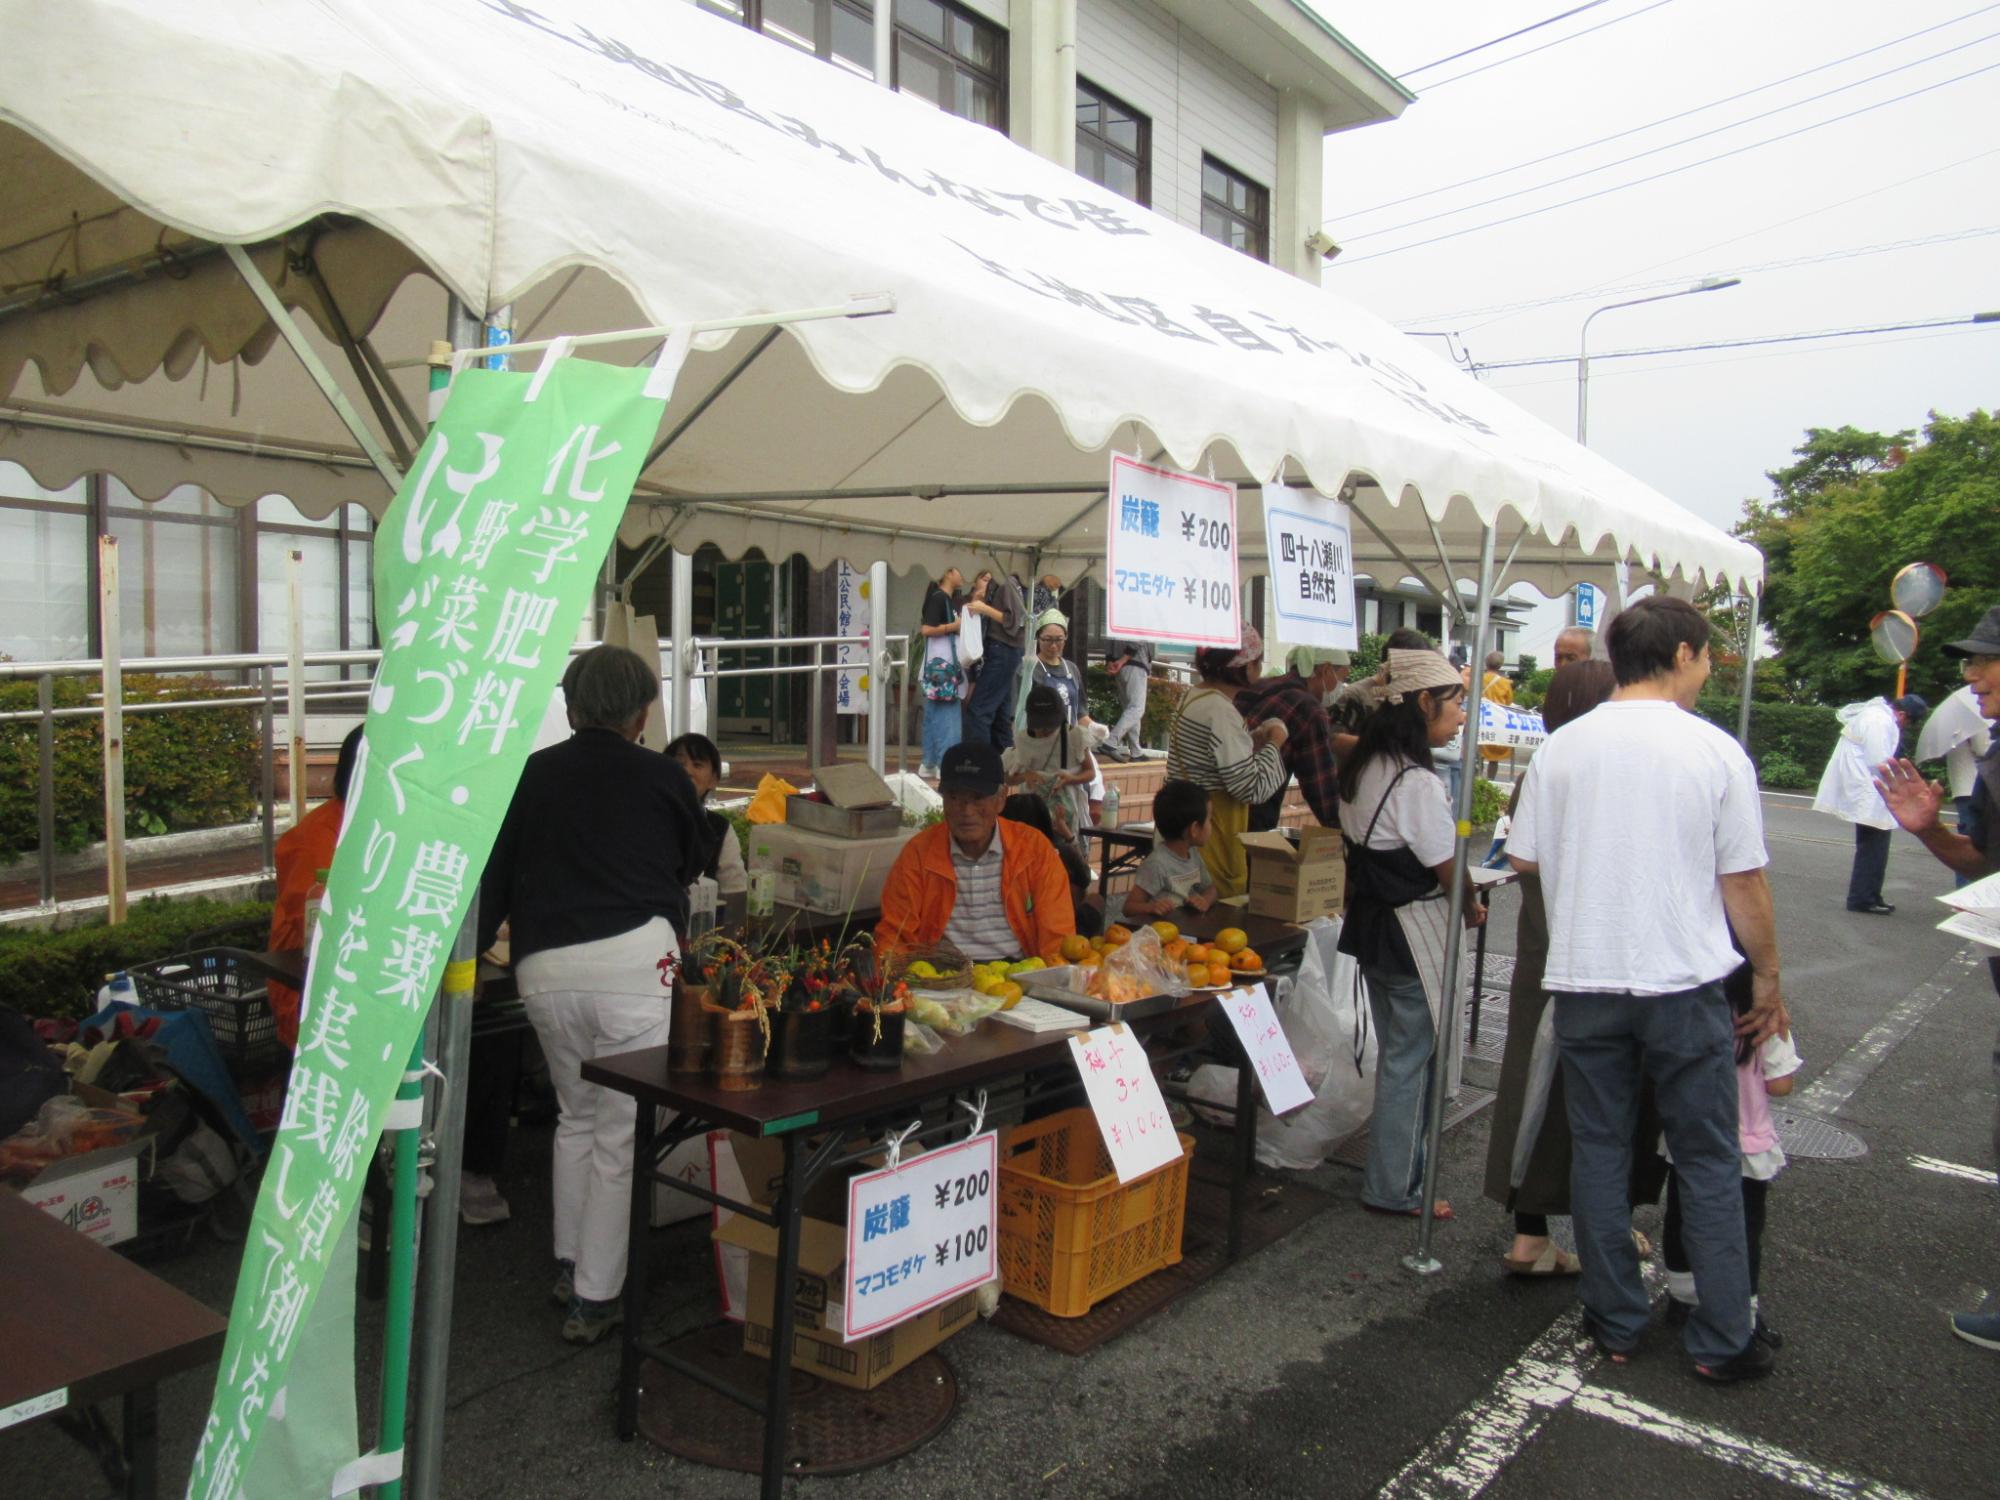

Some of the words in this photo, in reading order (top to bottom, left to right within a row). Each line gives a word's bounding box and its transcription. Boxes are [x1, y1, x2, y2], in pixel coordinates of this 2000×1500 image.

[1181, 511, 1230, 551] ¥200
[1281, 532, 1345, 574] 四十八瀬川
[1115, 569, 1176, 599] マコモダケ
[1184, 577, 1231, 611] ¥100
[1301, 570, 1336, 604] 自然村
[935, 1170, 989, 1209] ¥200
[855, 1254, 927, 1296] マコモダケ
[935, 1225, 988, 1266] ¥100
